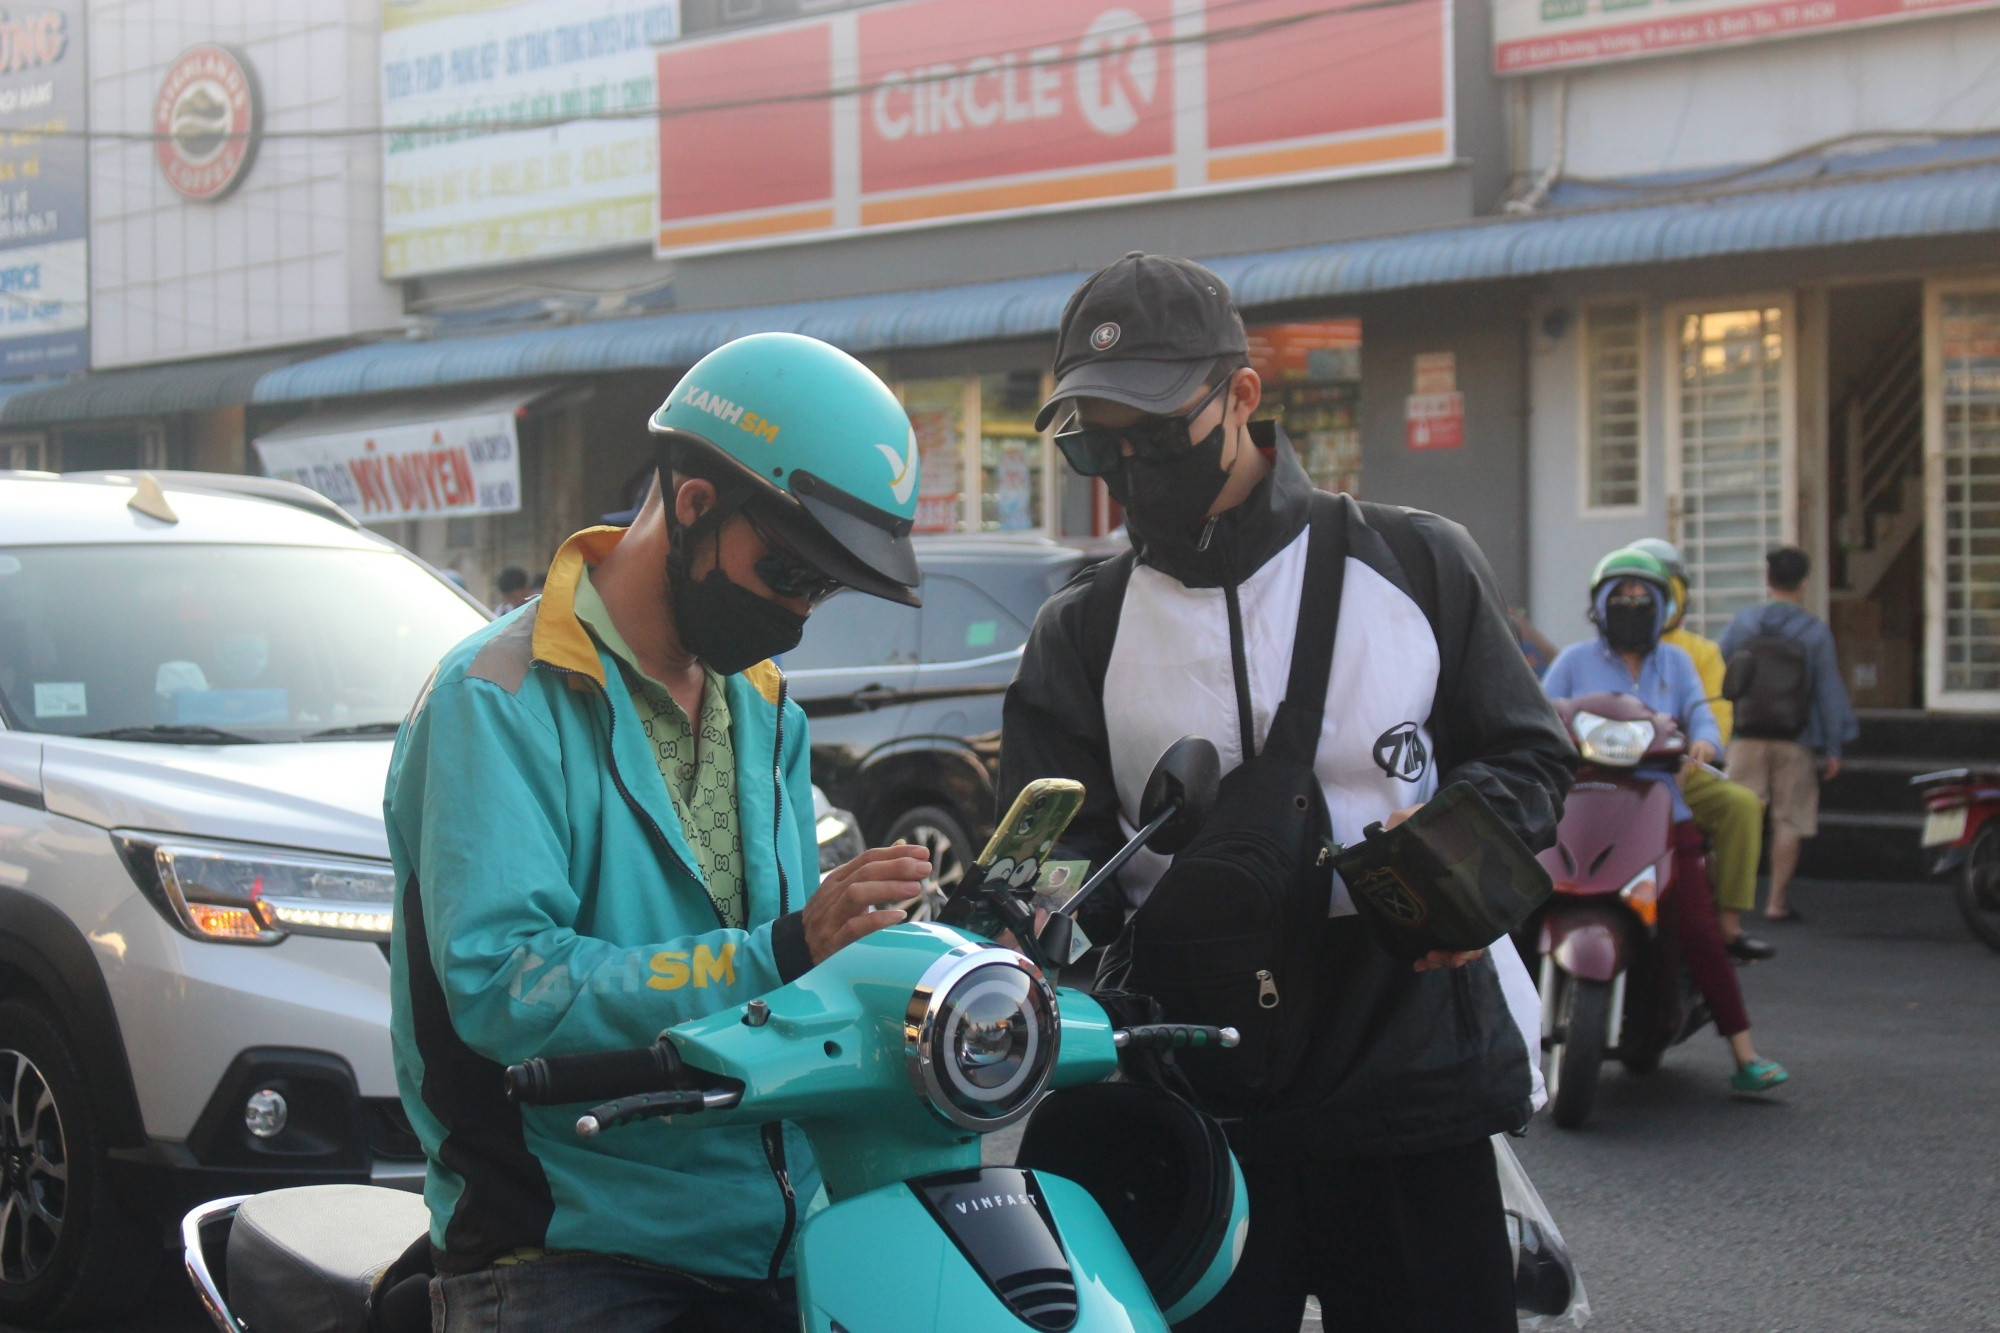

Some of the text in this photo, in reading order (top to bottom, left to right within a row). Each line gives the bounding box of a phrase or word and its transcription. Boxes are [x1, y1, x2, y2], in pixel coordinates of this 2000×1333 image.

[873, 46, 1064, 141] CIRCLE
[168, 151, 234, 189] COFFEE
[681, 386, 780, 444] XANH SM
[645, 942, 737, 992] SM
[955, 1193, 1038, 1215] VINFAST
